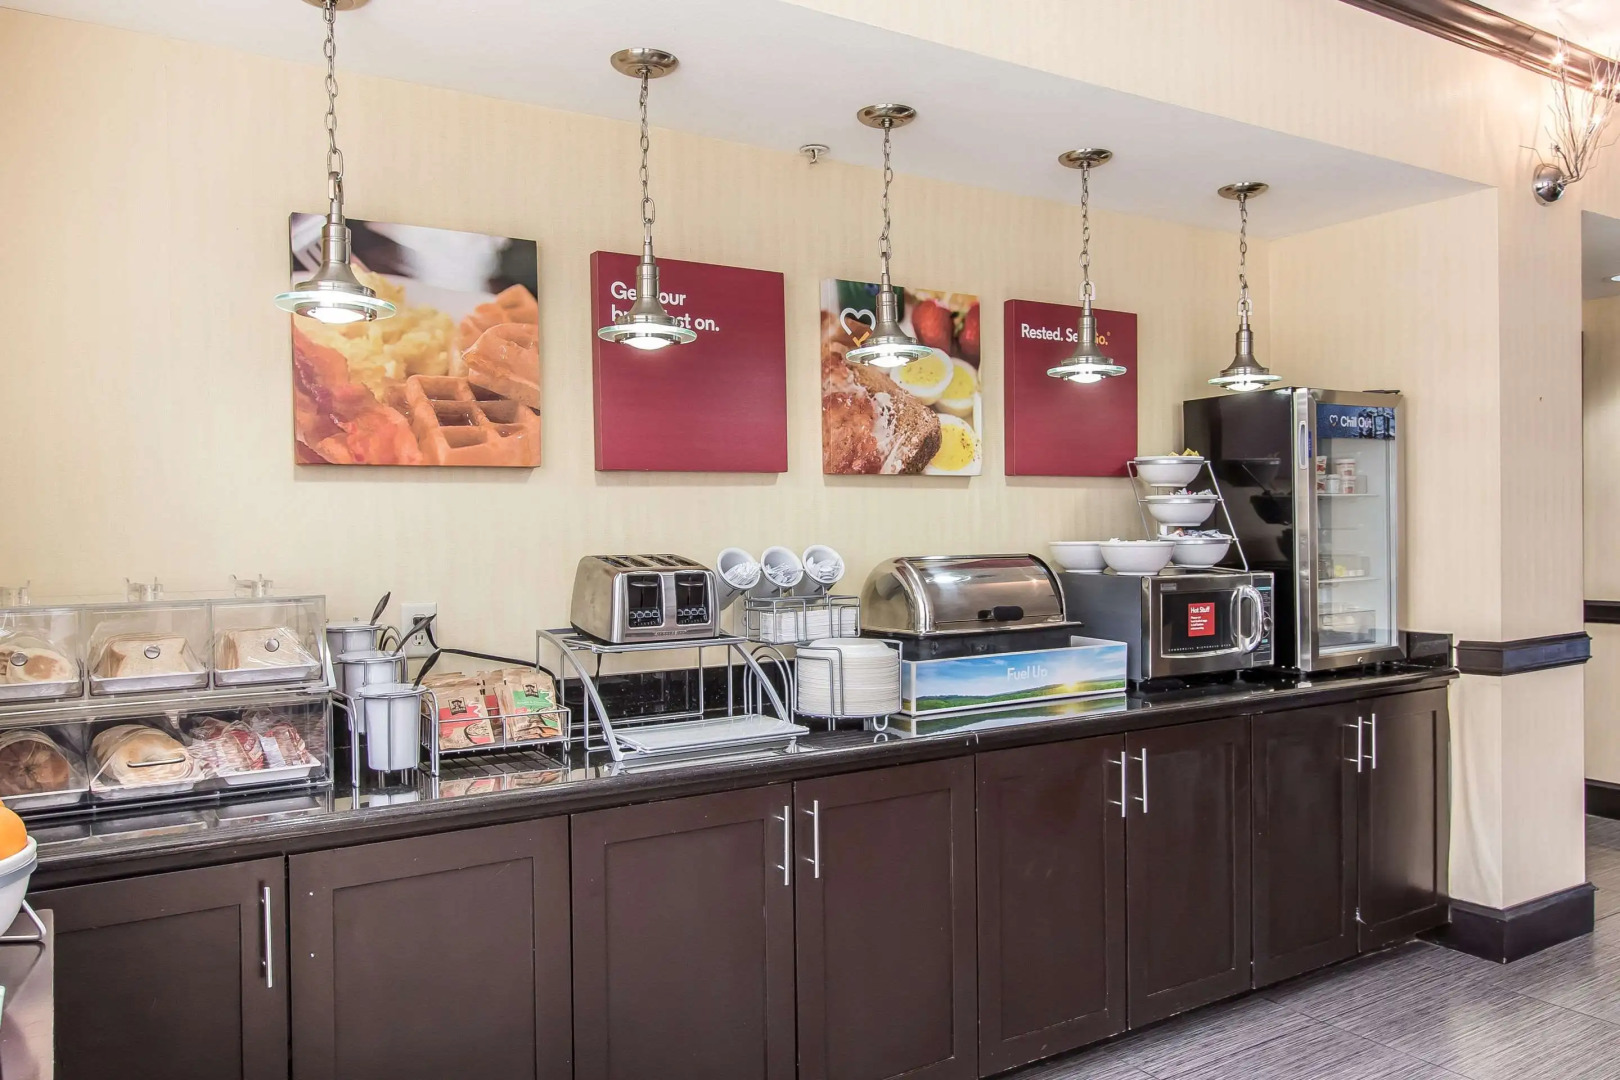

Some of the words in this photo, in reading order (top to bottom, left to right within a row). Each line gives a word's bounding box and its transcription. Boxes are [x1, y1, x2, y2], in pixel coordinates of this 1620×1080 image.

[610, 281, 638, 300] Ge
[657, 290, 686, 306] our
[694, 317, 720, 332] on.
[1021, 323, 1064, 342] Rested.
[1065, 327, 1079, 343] Se
[1340, 415, 1358, 428] Chill
[1358, 416, 1373, 429] Out
[1190, 606, 1200, 614] Hot
[1007, 665, 1030, 681] Fuel
[1032, 664, 1048, 680] Up
